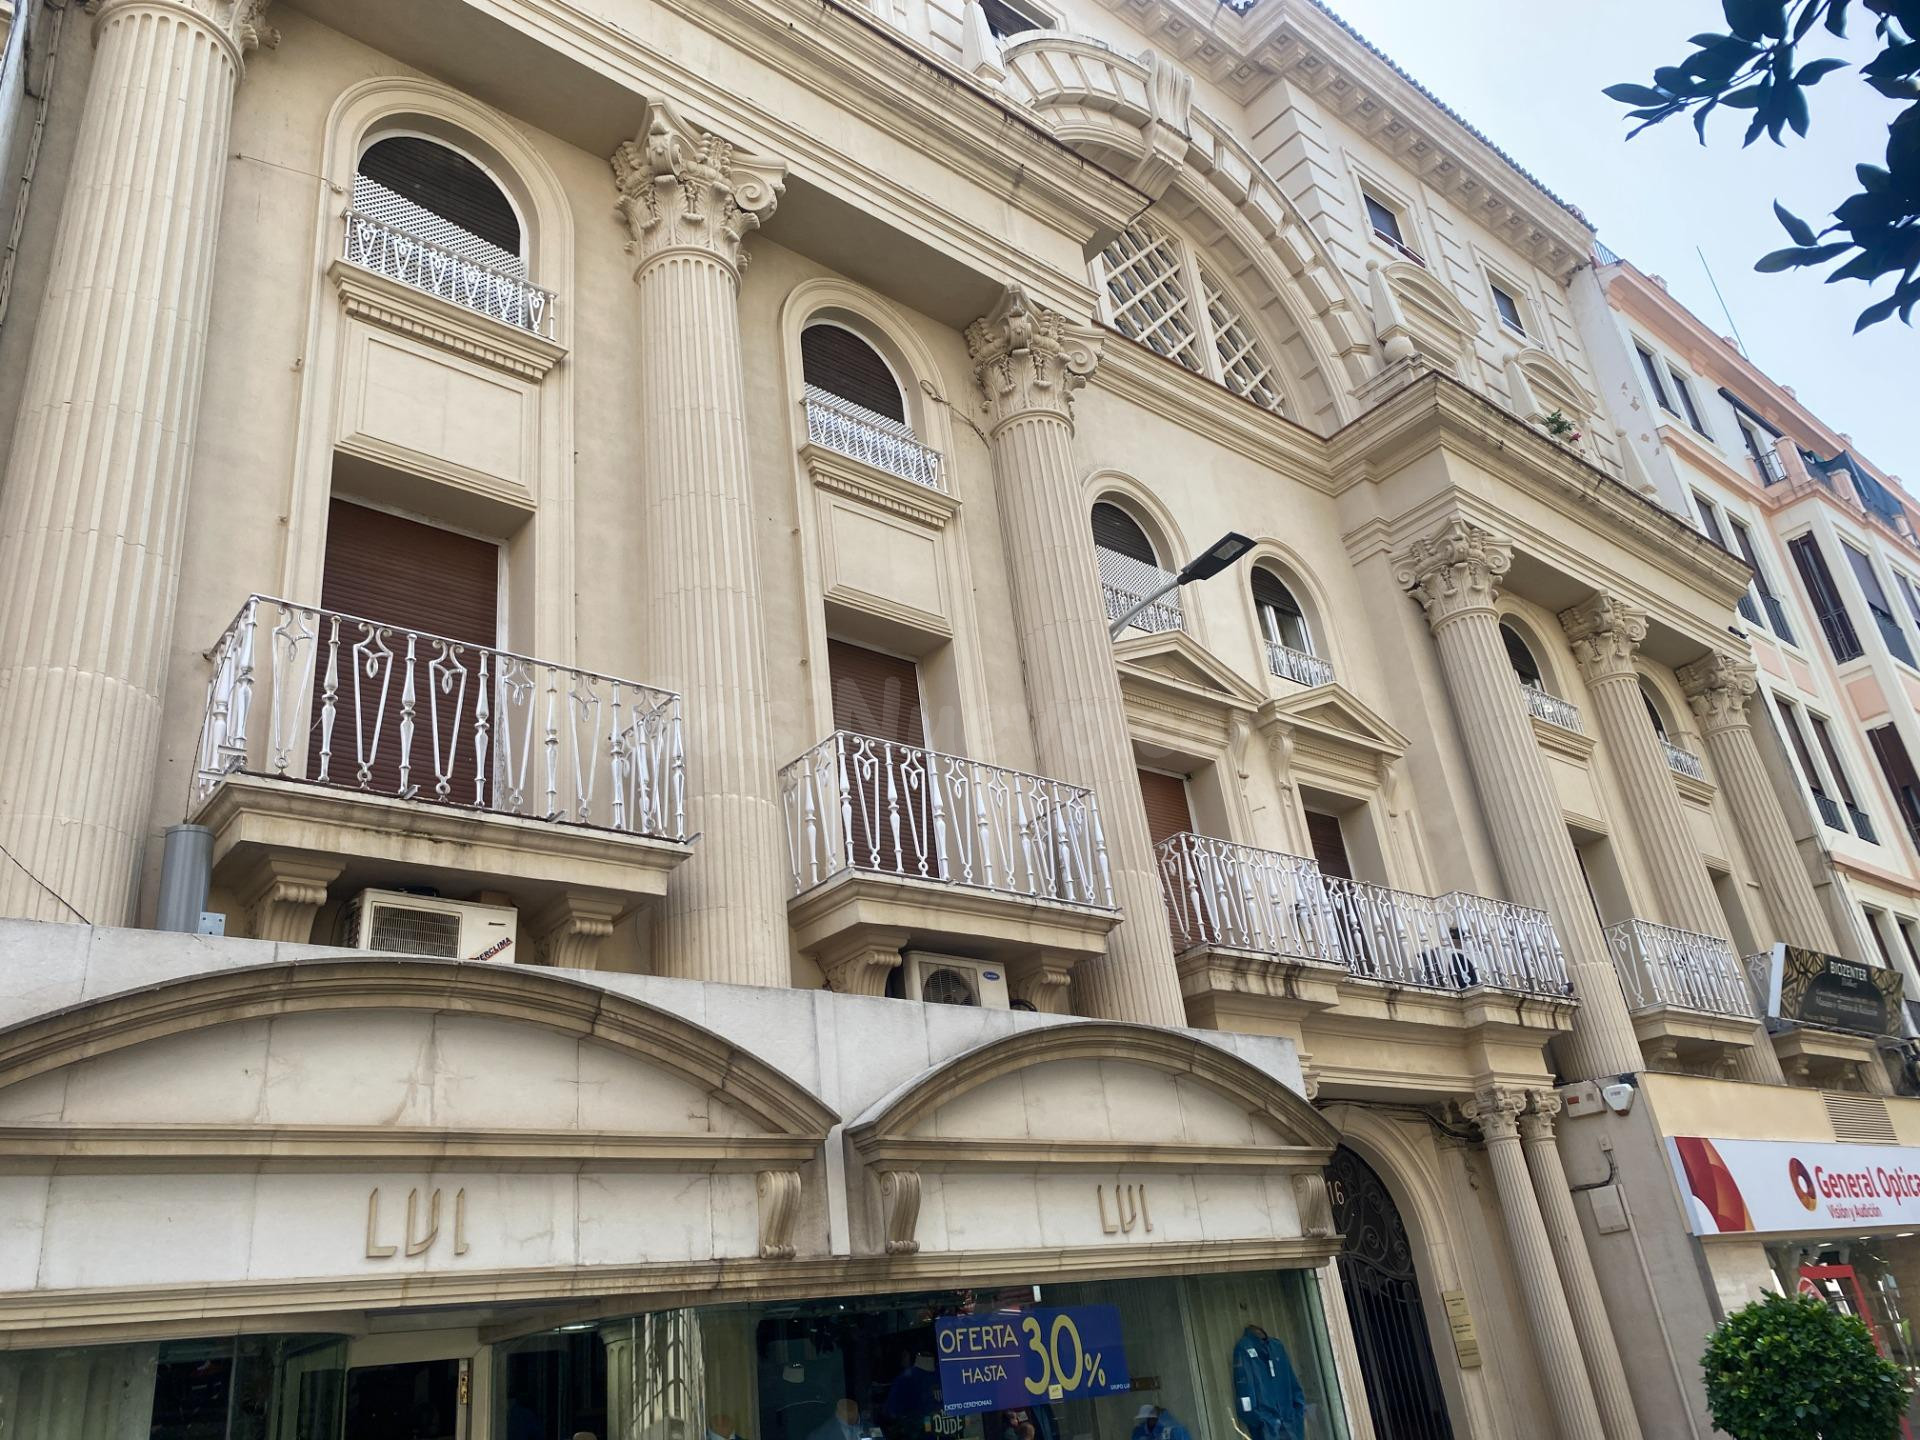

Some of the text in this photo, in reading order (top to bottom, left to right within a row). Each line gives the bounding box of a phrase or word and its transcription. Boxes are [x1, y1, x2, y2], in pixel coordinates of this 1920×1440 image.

[1829, 961, 1868, 981] BIOZENTER
[1326, 1180, 1345, 1206] 16
[1815, 1166, 1920, 1206] General Optica
[1097, 1184, 1153, 1234] LUI
[1826, 1203, 1850, 1219] Visión
[1854, 1203, 1883, 1218] Audición
[366, 1187, 470, 1259] LUI
[939, 1324, 1019, 1354] OFERTA
[961, 1364, 1008, 1385] HASTA
[933, 1414, 964, 1435] DUDE
